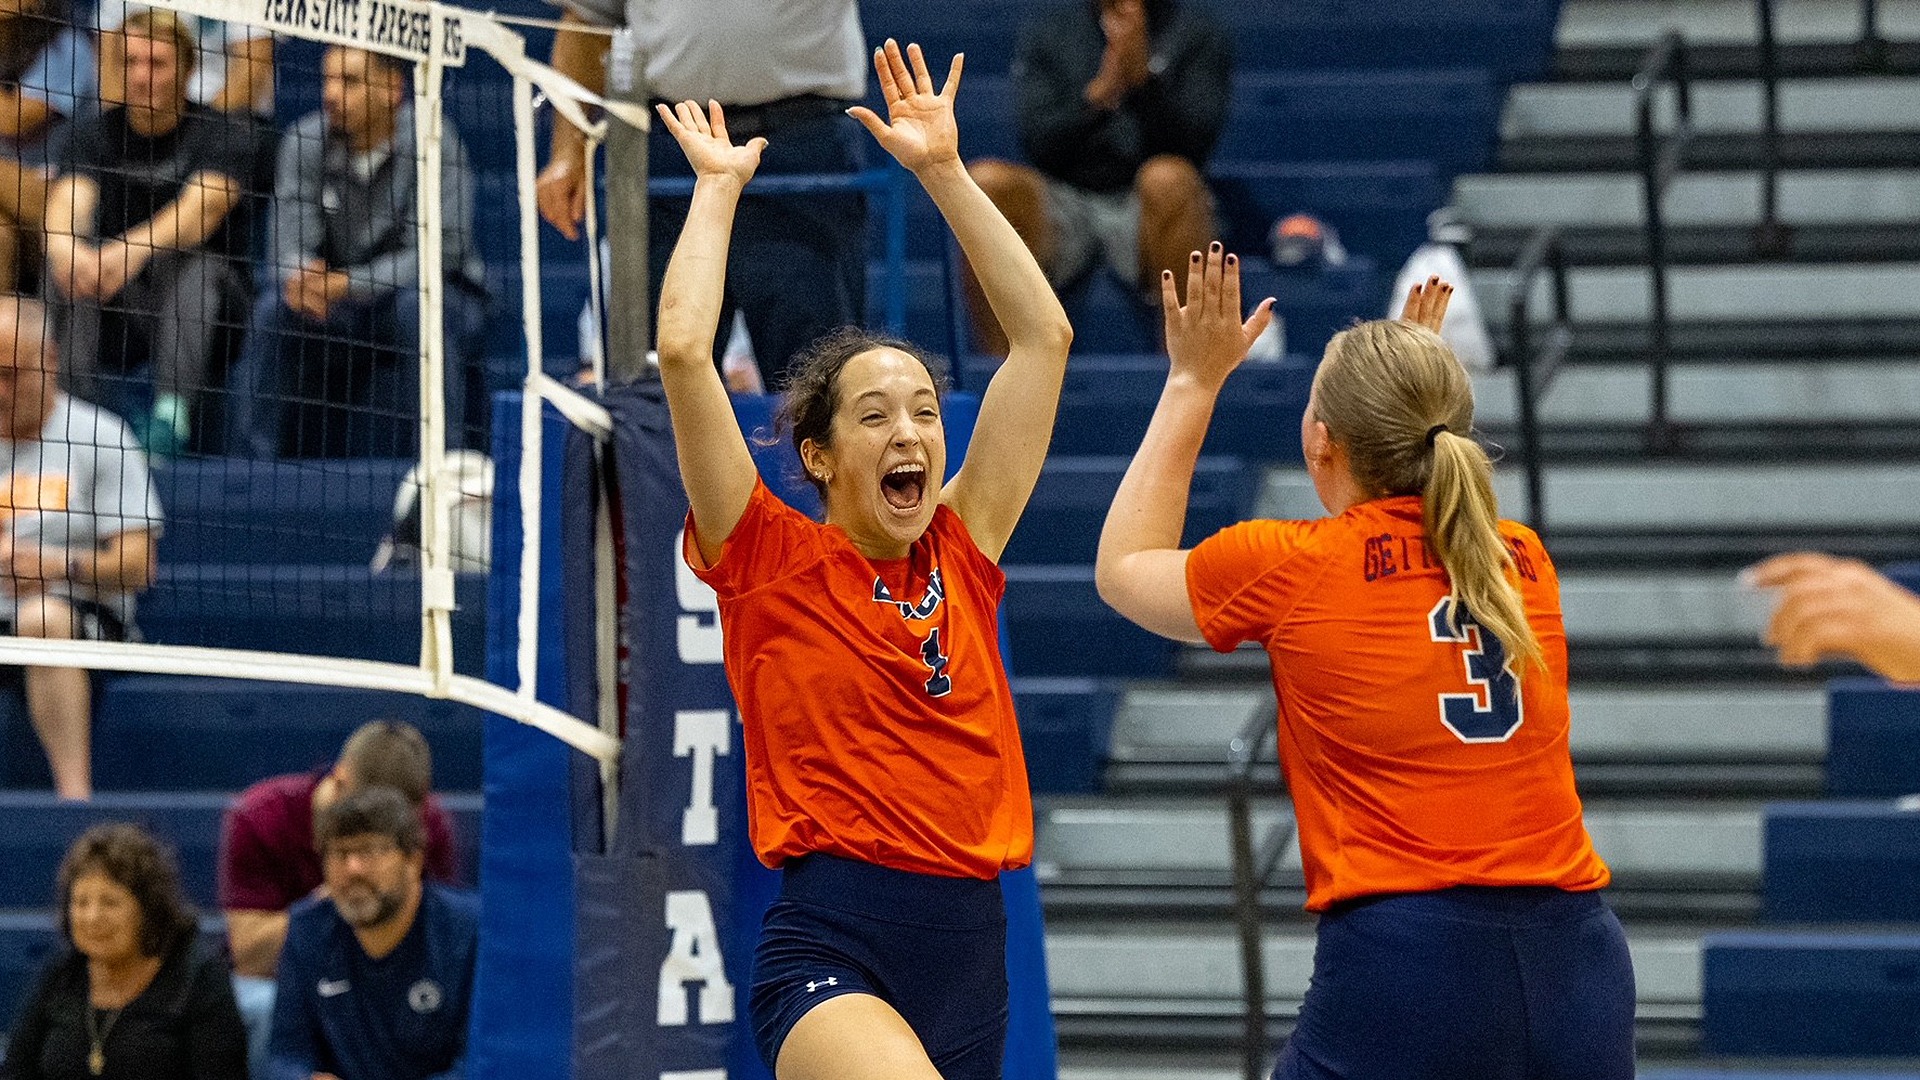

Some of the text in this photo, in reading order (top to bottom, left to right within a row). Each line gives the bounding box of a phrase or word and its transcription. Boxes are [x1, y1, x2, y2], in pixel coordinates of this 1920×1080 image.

[919, 627, 952, 698] 1
[1428, 595, 1524, 744] 3
[657, 523, 735, 1080] STA
